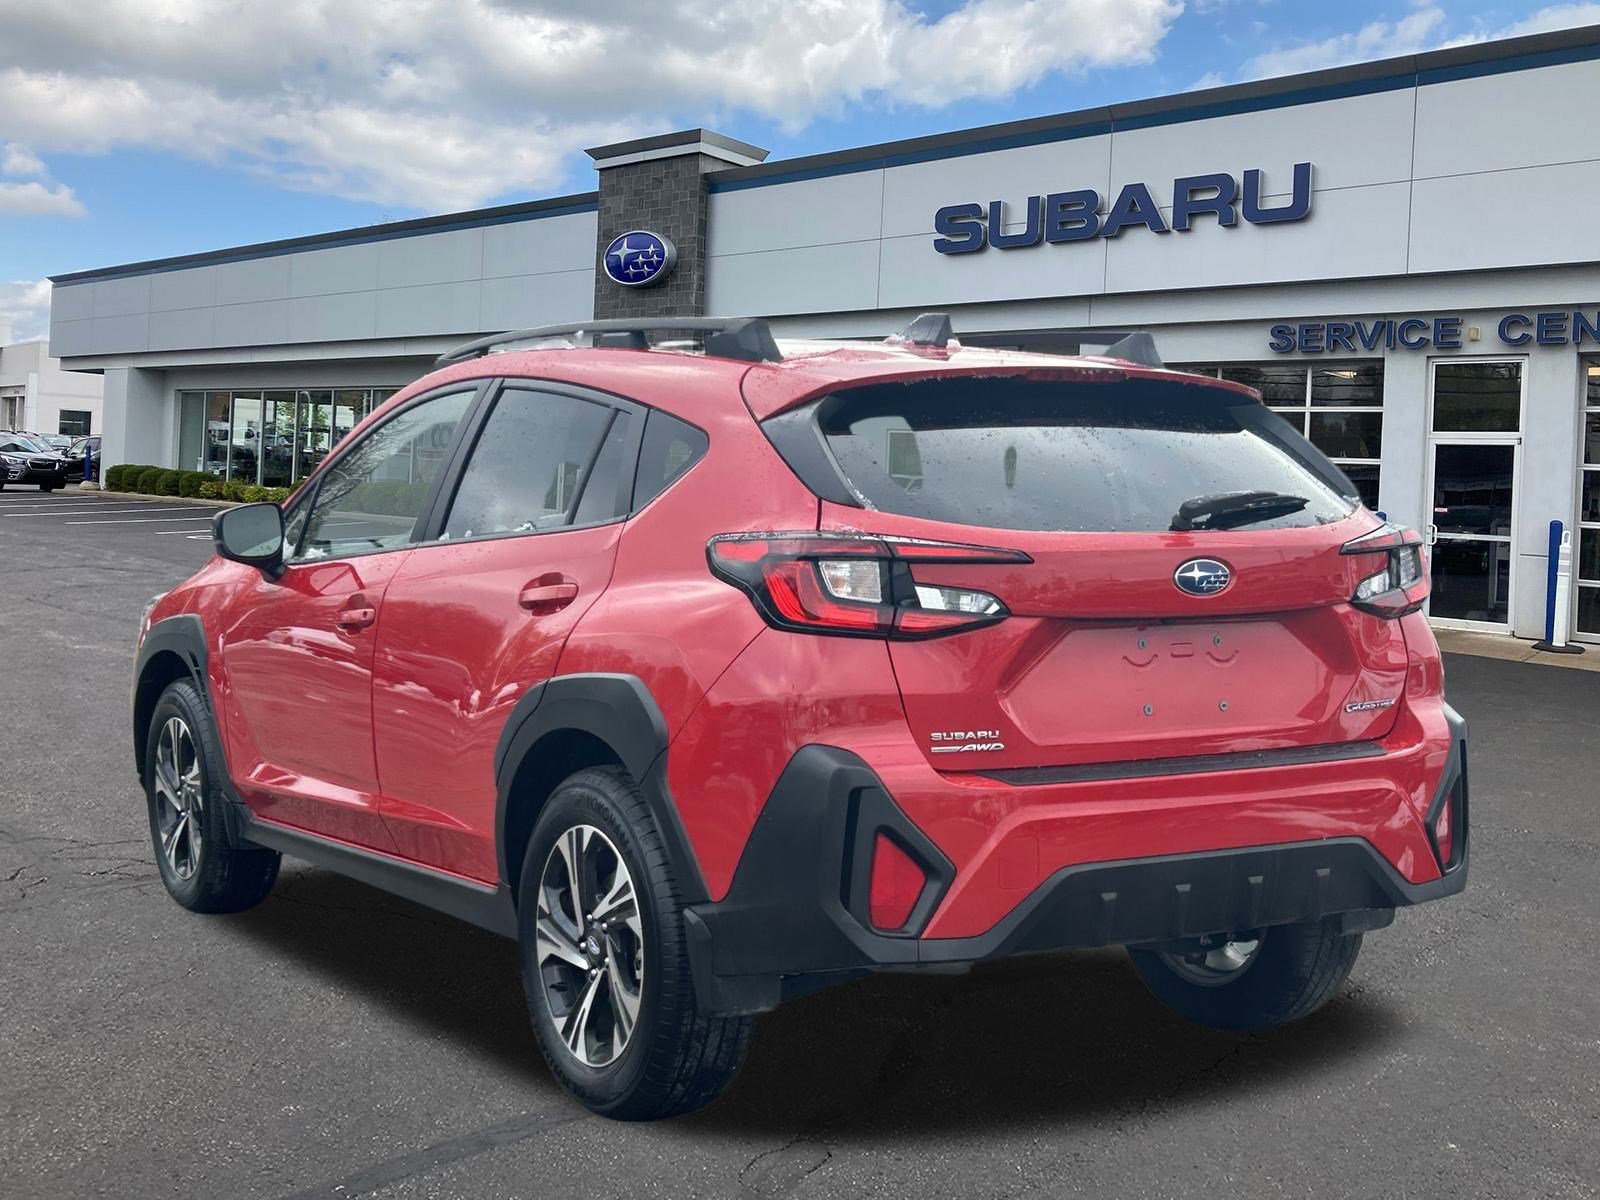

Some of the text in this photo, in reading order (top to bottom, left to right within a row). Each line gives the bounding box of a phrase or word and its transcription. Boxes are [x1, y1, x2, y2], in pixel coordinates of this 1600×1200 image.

[933, 162, 1313, 255] SUBARU
[1268, 311, 1600, 353] SERVICE CEN
[930, 729, 1000, 741] SUBARU
[957, 742, 1005, 752] AWD
